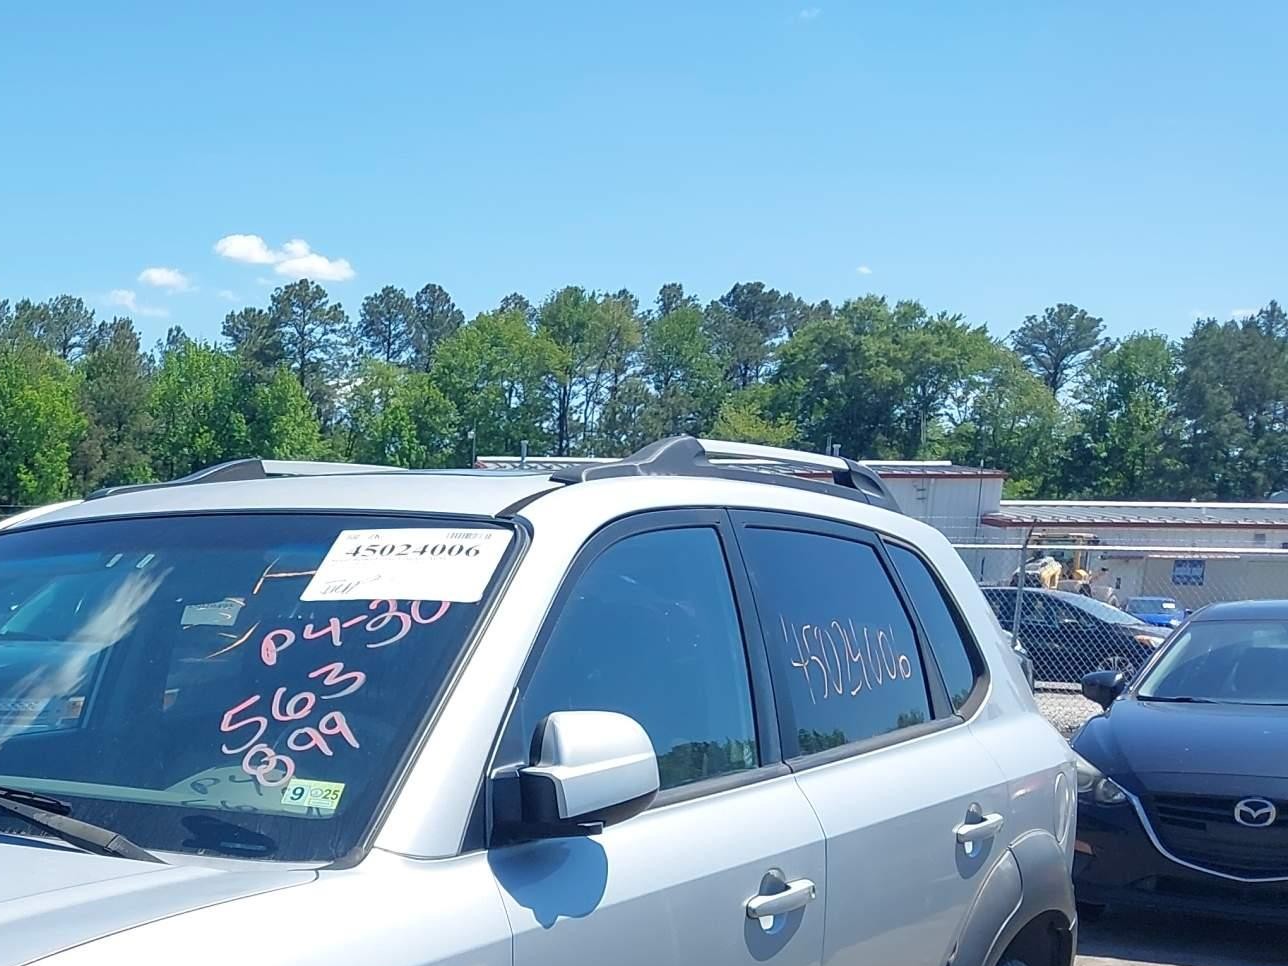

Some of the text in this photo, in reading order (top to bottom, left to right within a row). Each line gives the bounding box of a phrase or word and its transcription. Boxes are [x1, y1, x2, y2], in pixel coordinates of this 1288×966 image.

[344, 543, 482, 558] 45024006
[220, 661, 366, 754] 563
[289, 786, 340, 801] 9 25
